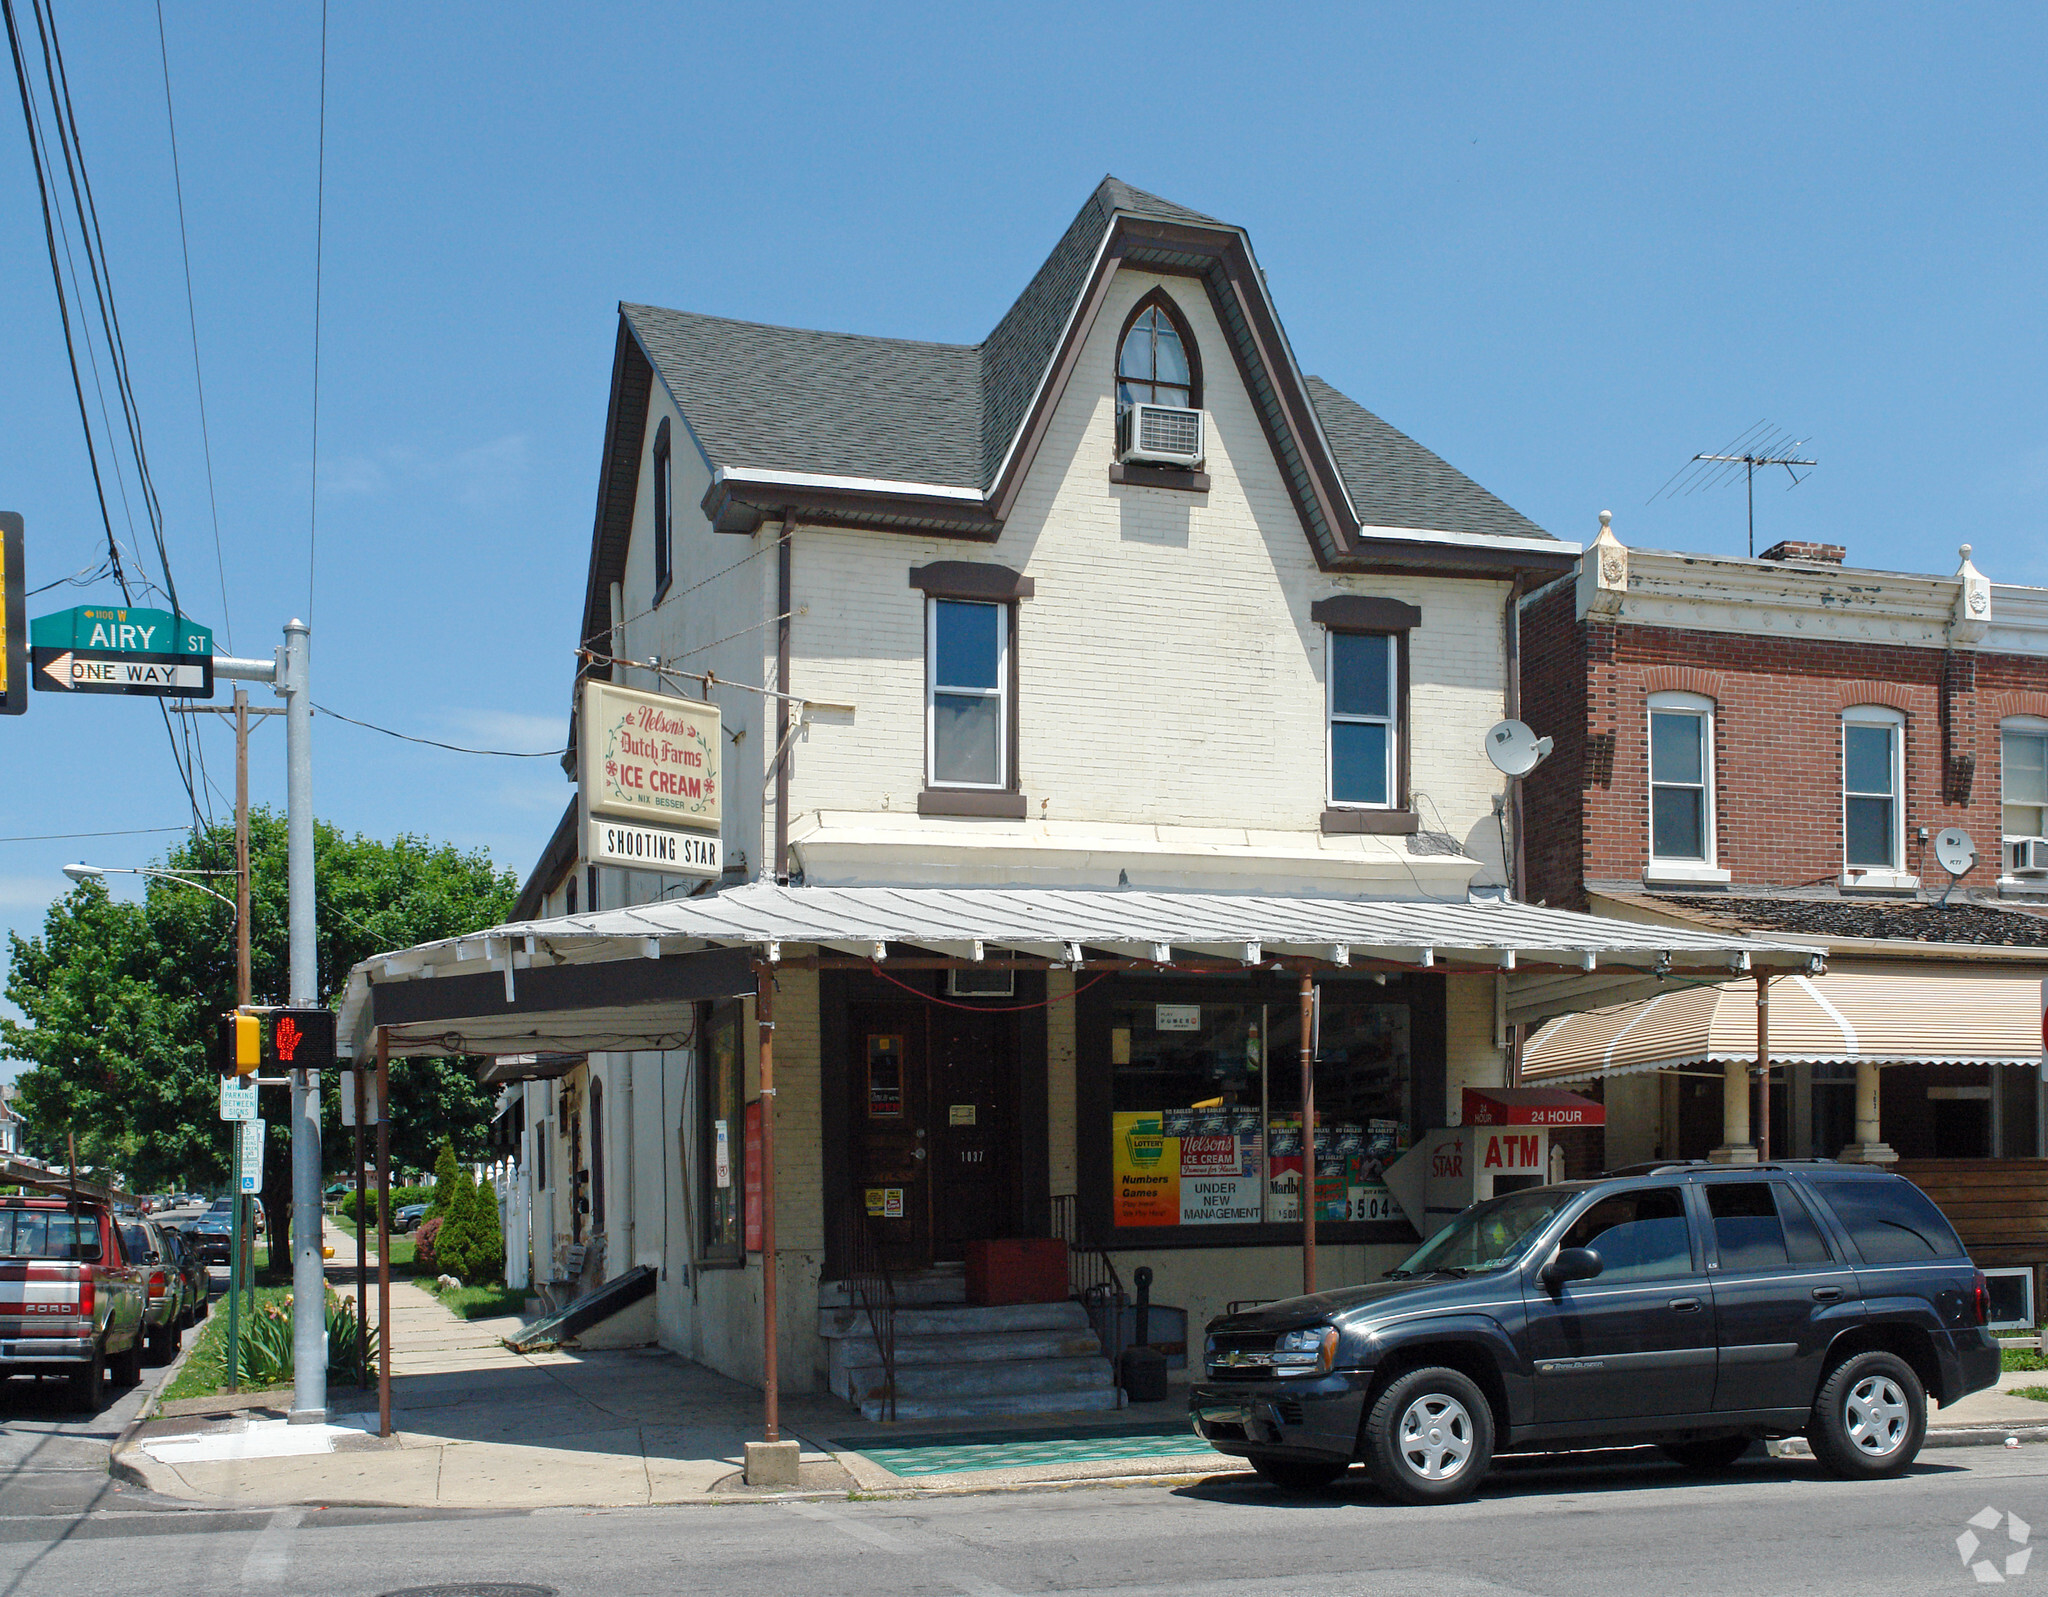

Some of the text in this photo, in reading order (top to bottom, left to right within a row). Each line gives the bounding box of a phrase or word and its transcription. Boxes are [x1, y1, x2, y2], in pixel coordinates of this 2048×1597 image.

[117, 610, 127, 622] W
[89, 623, 206, 652] AIRY ST
[72, 663, 176, 683] ONE WAY
[638, 705, 684, 736] Nelson's
[621, 730, 702, 768] Dutch Farms
[620, 764, 701, 799] ICE CREAM
[638, 794, 685, 809] NIX BESSER
[608, 829, 716, 866] SHOOTING STAR
[224, 1091, 254, 1099] PARKING
[223, 1099, 254, 1107] BETWEEN
[1479, 1104, 1487, 1113] 24
[228, 1107, 249, 1116] SIGNS
[1531, 1111, 1582, 1122] 24 HOUR
[1474, 1113, 1492, 1122] HOUR
[1181, 1135, 1233, 1154] Nelson's
[961, 1151, 984, 1162] 1037
[1484, 1135, 1539, 1168] ATM
[1183, 1155, 1198, 1164] ICE
[1201, 1154, 1232, 1164] CREAM
[1432, 1155, 1463, 1178] STAR
[1122, 1175, 1168, 1184] Numbers
[1195, 1183, 1236, 1194] UNDER
[1270, 1177, 1299, 1195] Marlb
[1122, 1189, 1158, 1197] Games
[1203, 1196, 1230, 1206] NEW
[1184, 1208, 1261, 1220] MANAGEMENT
[25, 1304, 71, 1313] FORD
